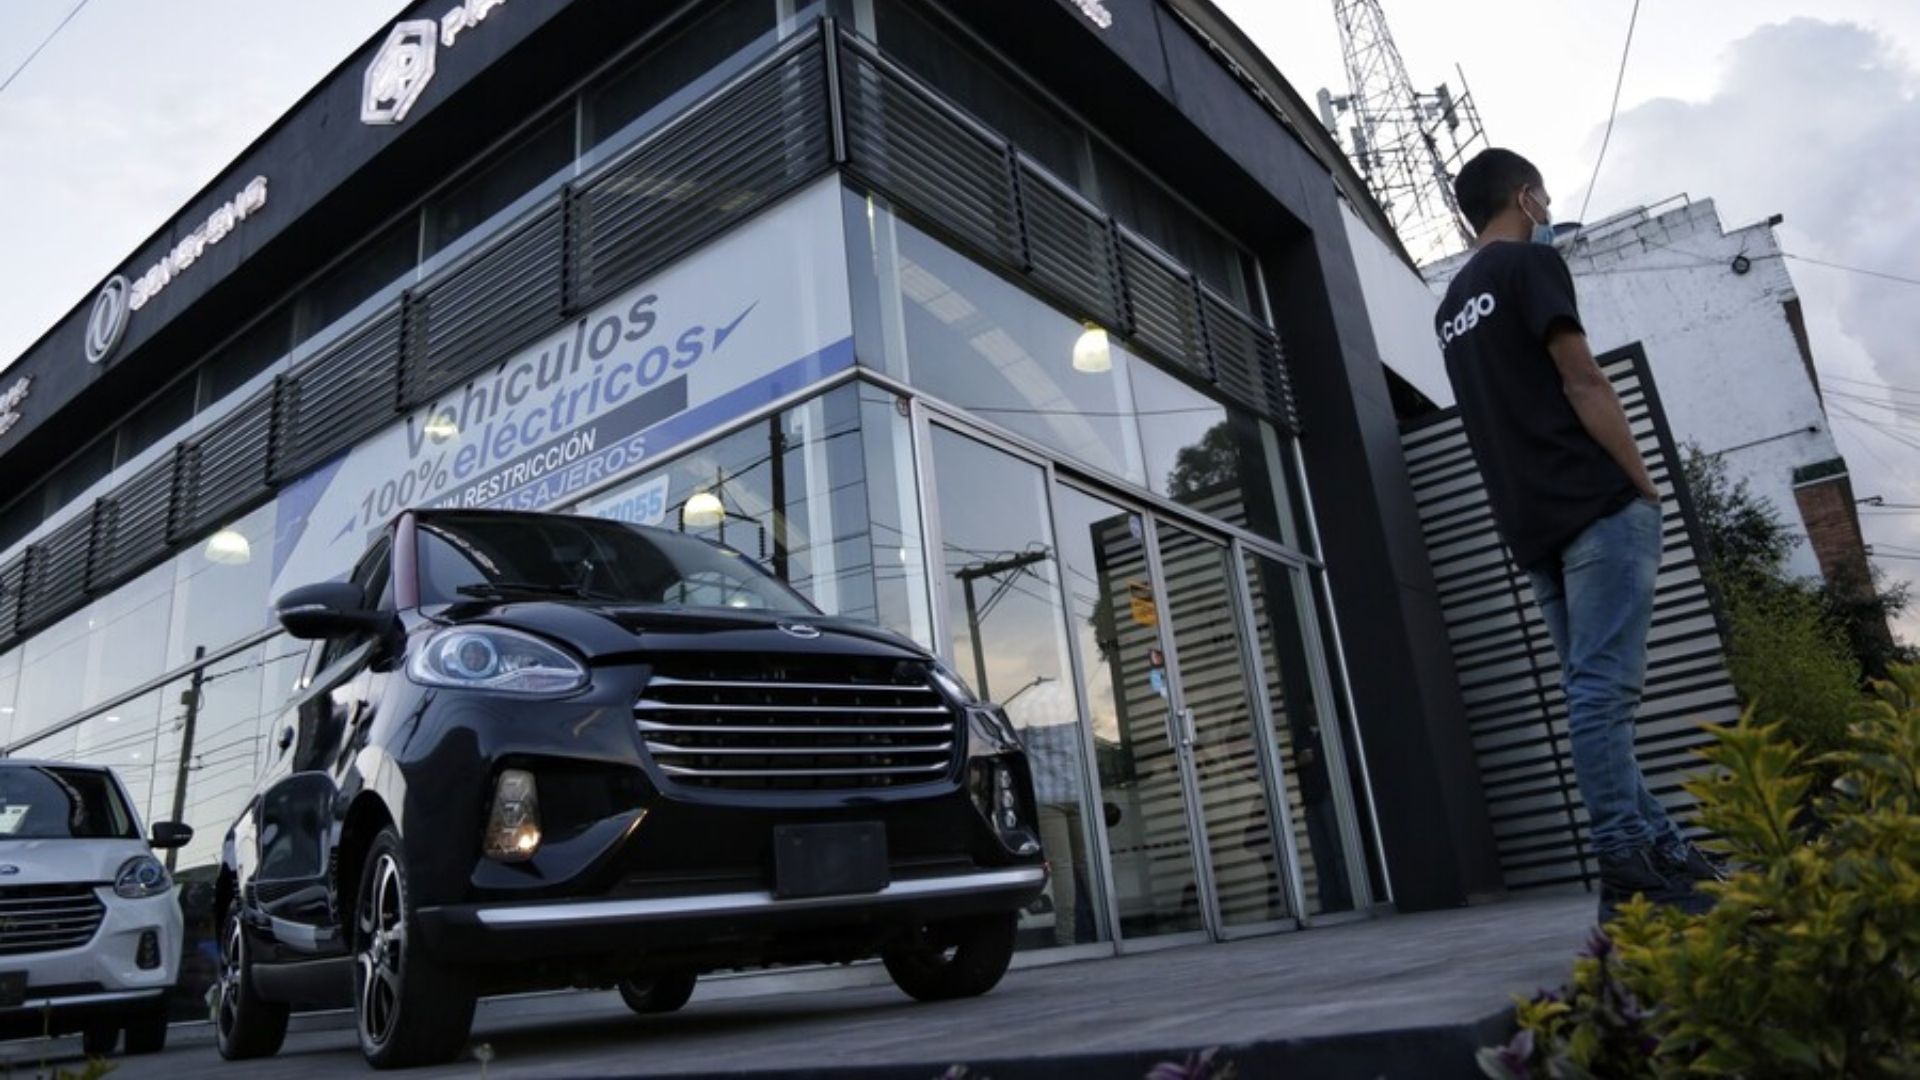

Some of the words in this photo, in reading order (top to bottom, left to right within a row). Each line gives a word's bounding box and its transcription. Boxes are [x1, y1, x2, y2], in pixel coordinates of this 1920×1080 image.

[1440, 292, 1494, 350] cago
[405, 294, 658, 459] Vehículos
[361, 450, 448, 526] 100%
[453, 325, 705, 479] eléctricos
[464, 428, 597, 508] RESTRICCIÓN
[489, 437, 646, 511] ASAJEROS
